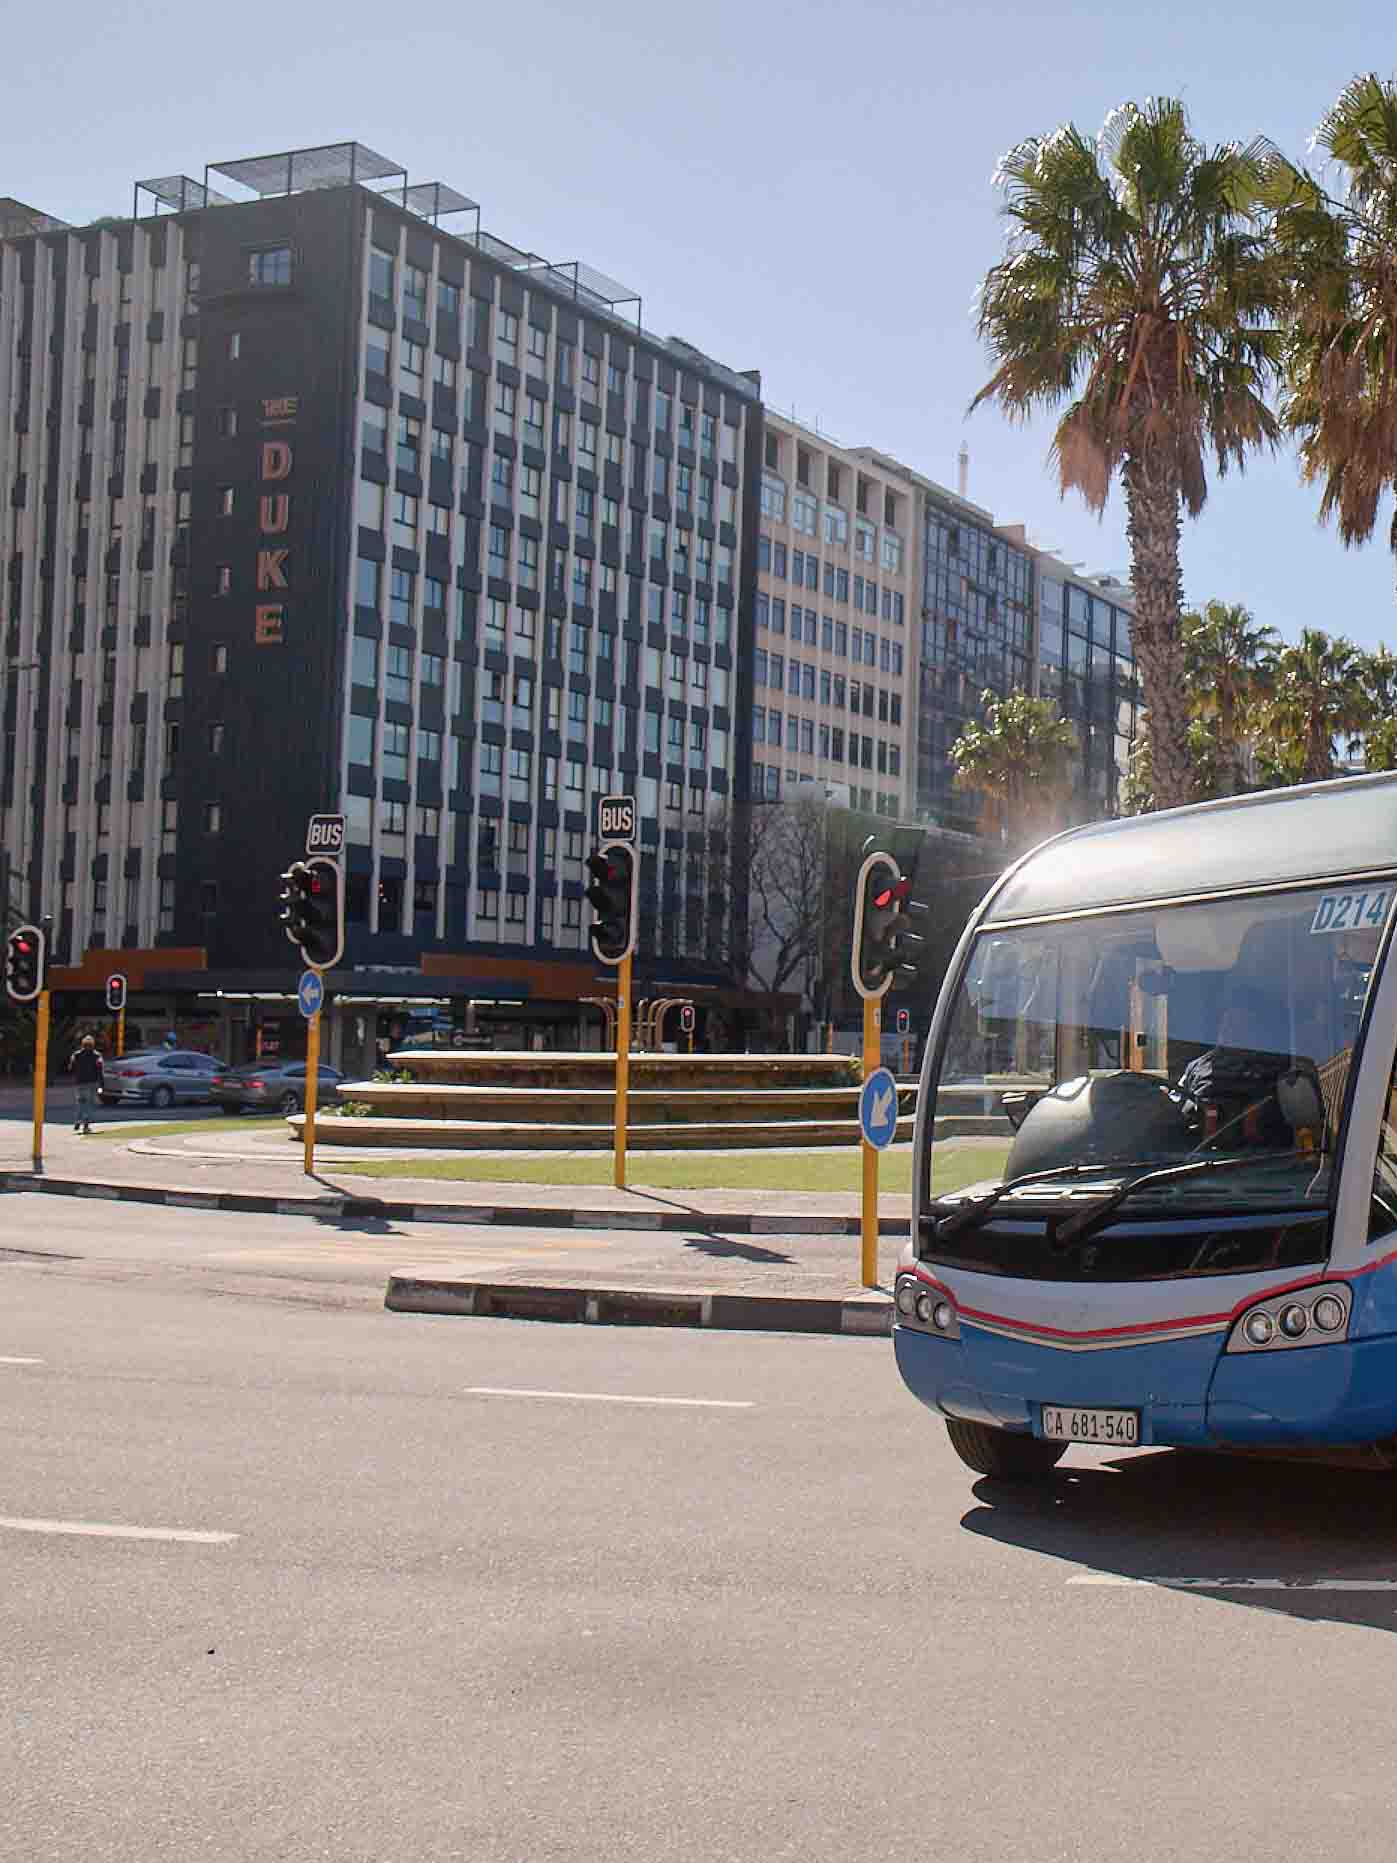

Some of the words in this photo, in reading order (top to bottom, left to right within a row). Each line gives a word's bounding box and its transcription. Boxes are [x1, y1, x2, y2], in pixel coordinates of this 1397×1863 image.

[262, 397, 297, 417] THE
[256, 441, 293, 646] DUKE
[601, 805, 634, 833] BUS
[310, 823, 343, 848] BUS
[1045, 1411, 1063, 1435] CA
[1071, 1413, 1136, 1441] 681-540
